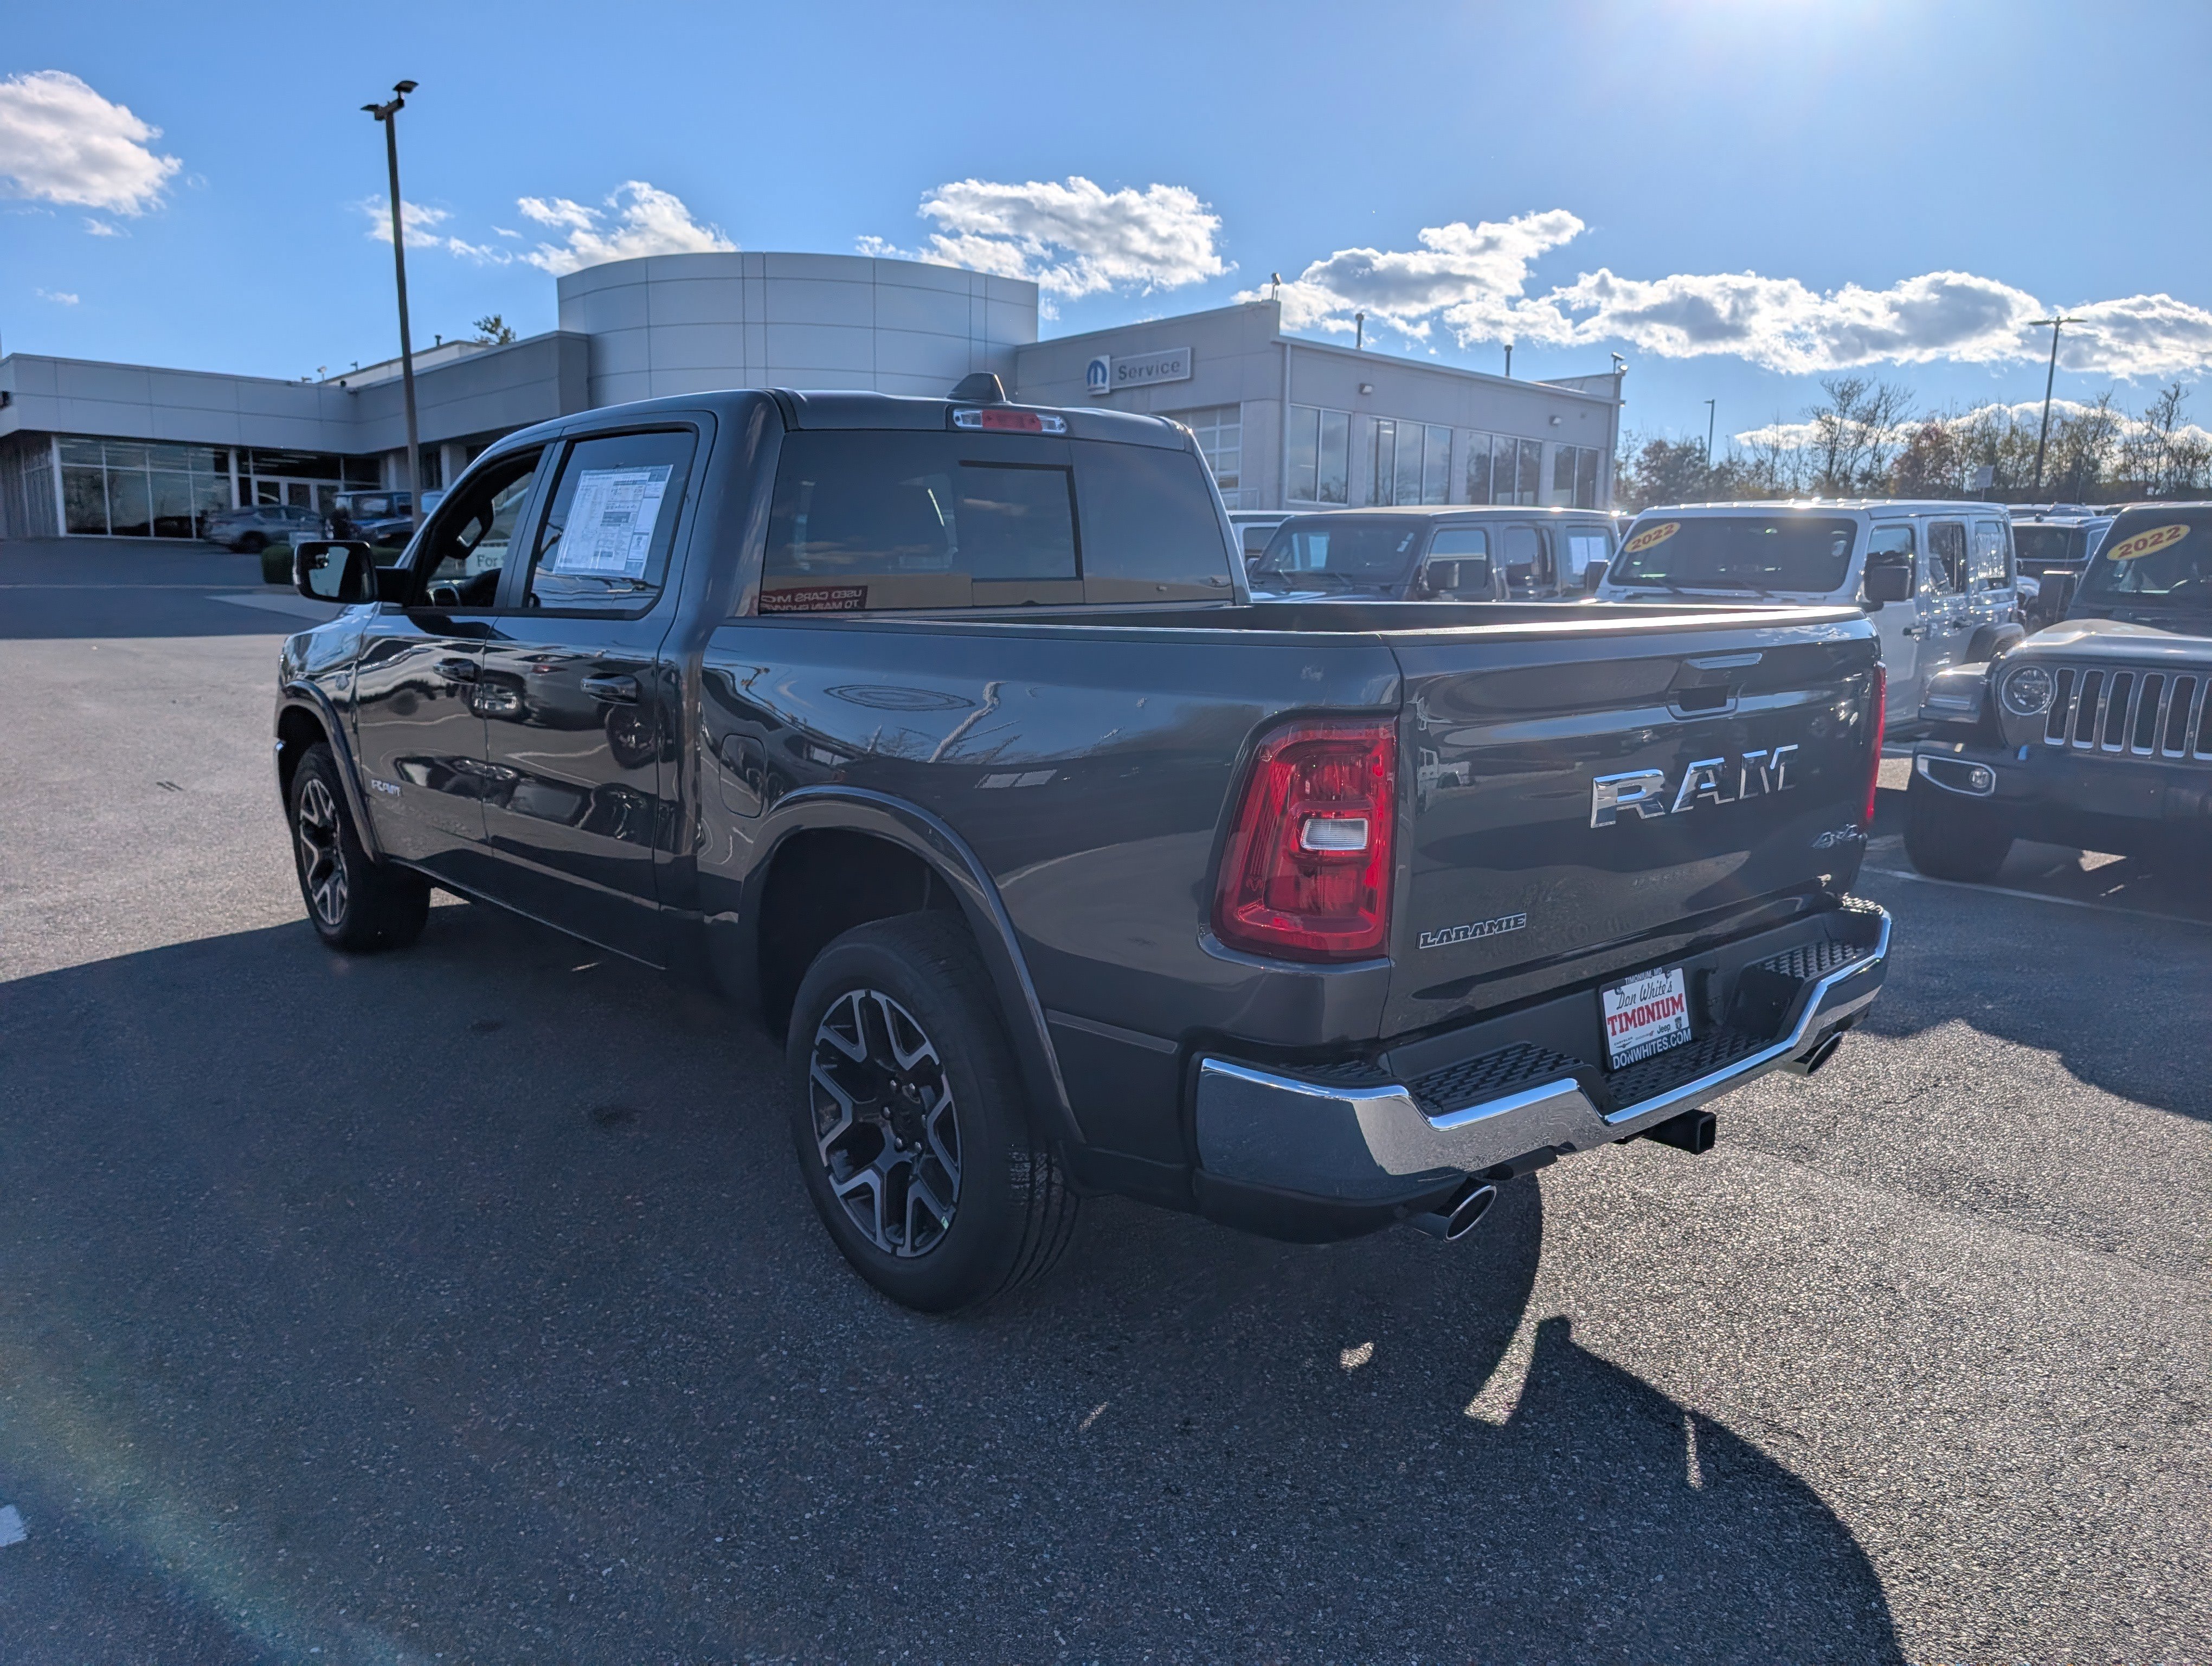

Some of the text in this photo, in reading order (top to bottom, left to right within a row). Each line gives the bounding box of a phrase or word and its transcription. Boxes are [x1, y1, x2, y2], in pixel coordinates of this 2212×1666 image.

[1118, 360, 1180, 380] Service
[2118, 526, 2181, 559] 2022
[1591, 744, 1798, 829] RAM
[1416, 912, 1527, 949] LARAMIE
[1616, 980, 1673, 1010] Don White's
[1607, 992, 1684, 1037] TIMONIUM
[1657, 1023, 1671, 1034] Jeep
[1612, 1028, 1692, 1070] DONWHITES.COM
